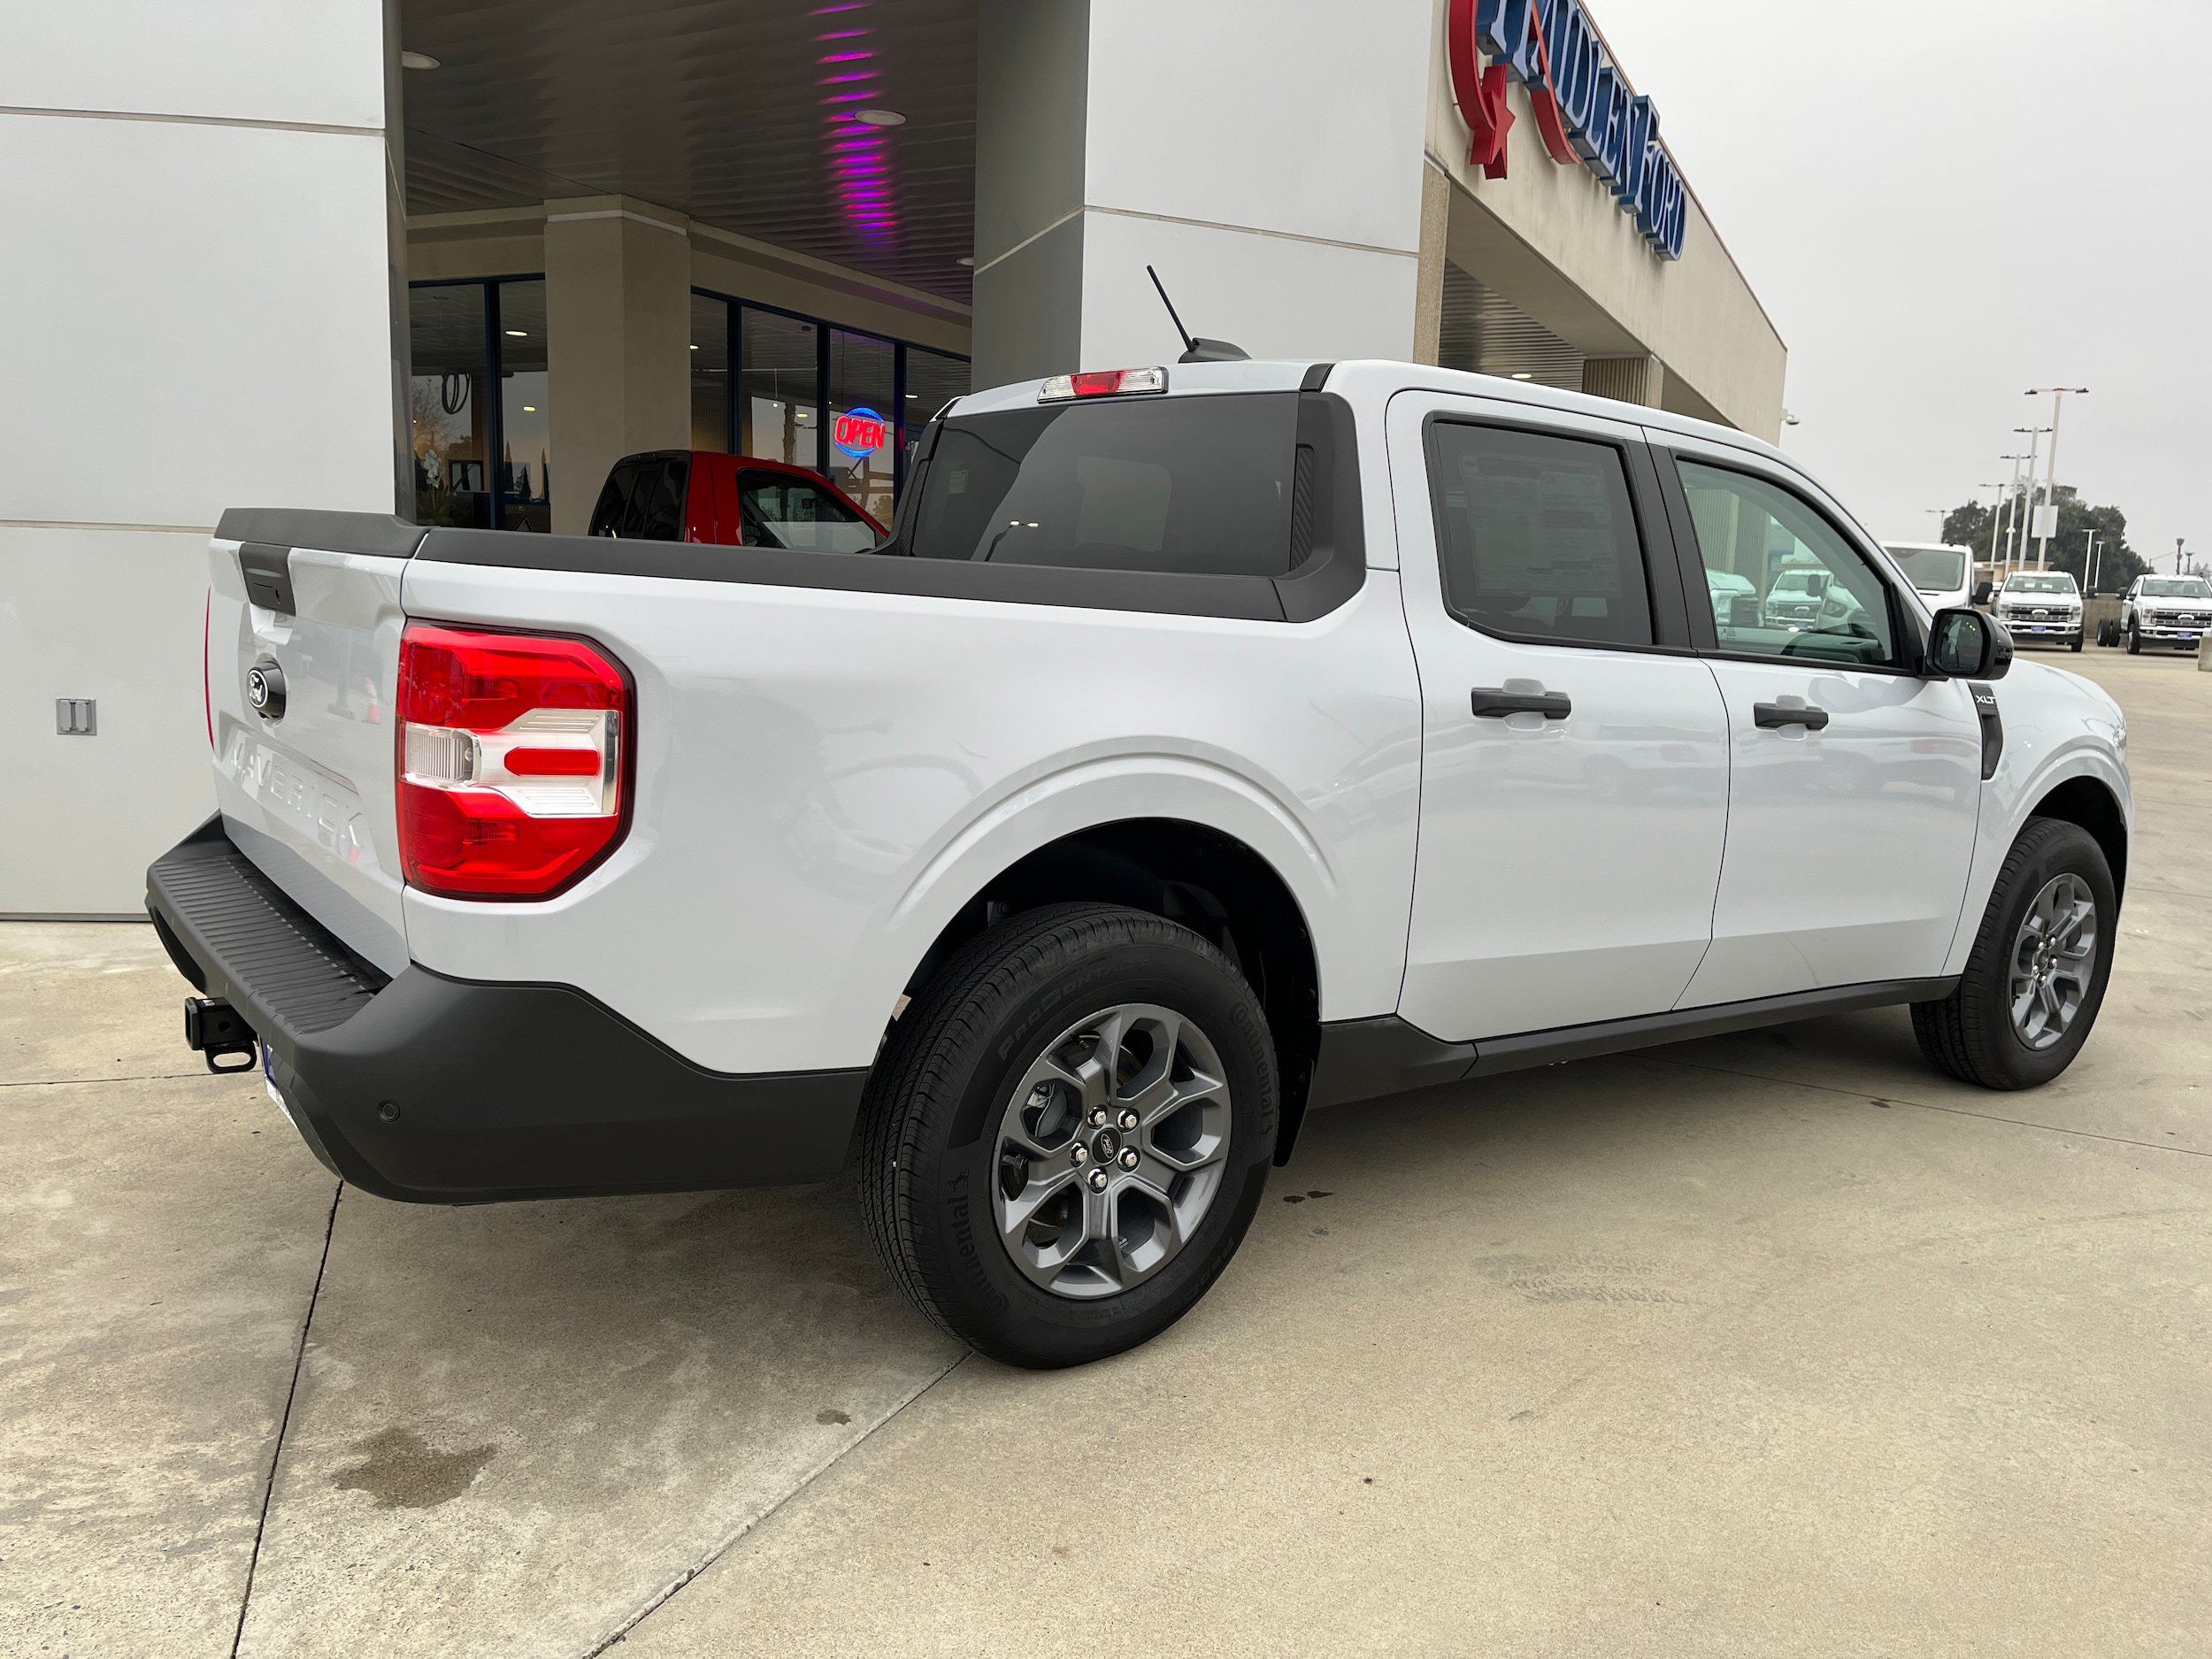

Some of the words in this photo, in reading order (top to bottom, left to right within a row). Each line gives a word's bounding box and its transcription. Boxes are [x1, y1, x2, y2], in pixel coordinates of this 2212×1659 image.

[1634, 96, 1687, 261] FORD
[834, 415, 885, 449] OPEN
[1975, 695, 1996, 704] XLT
